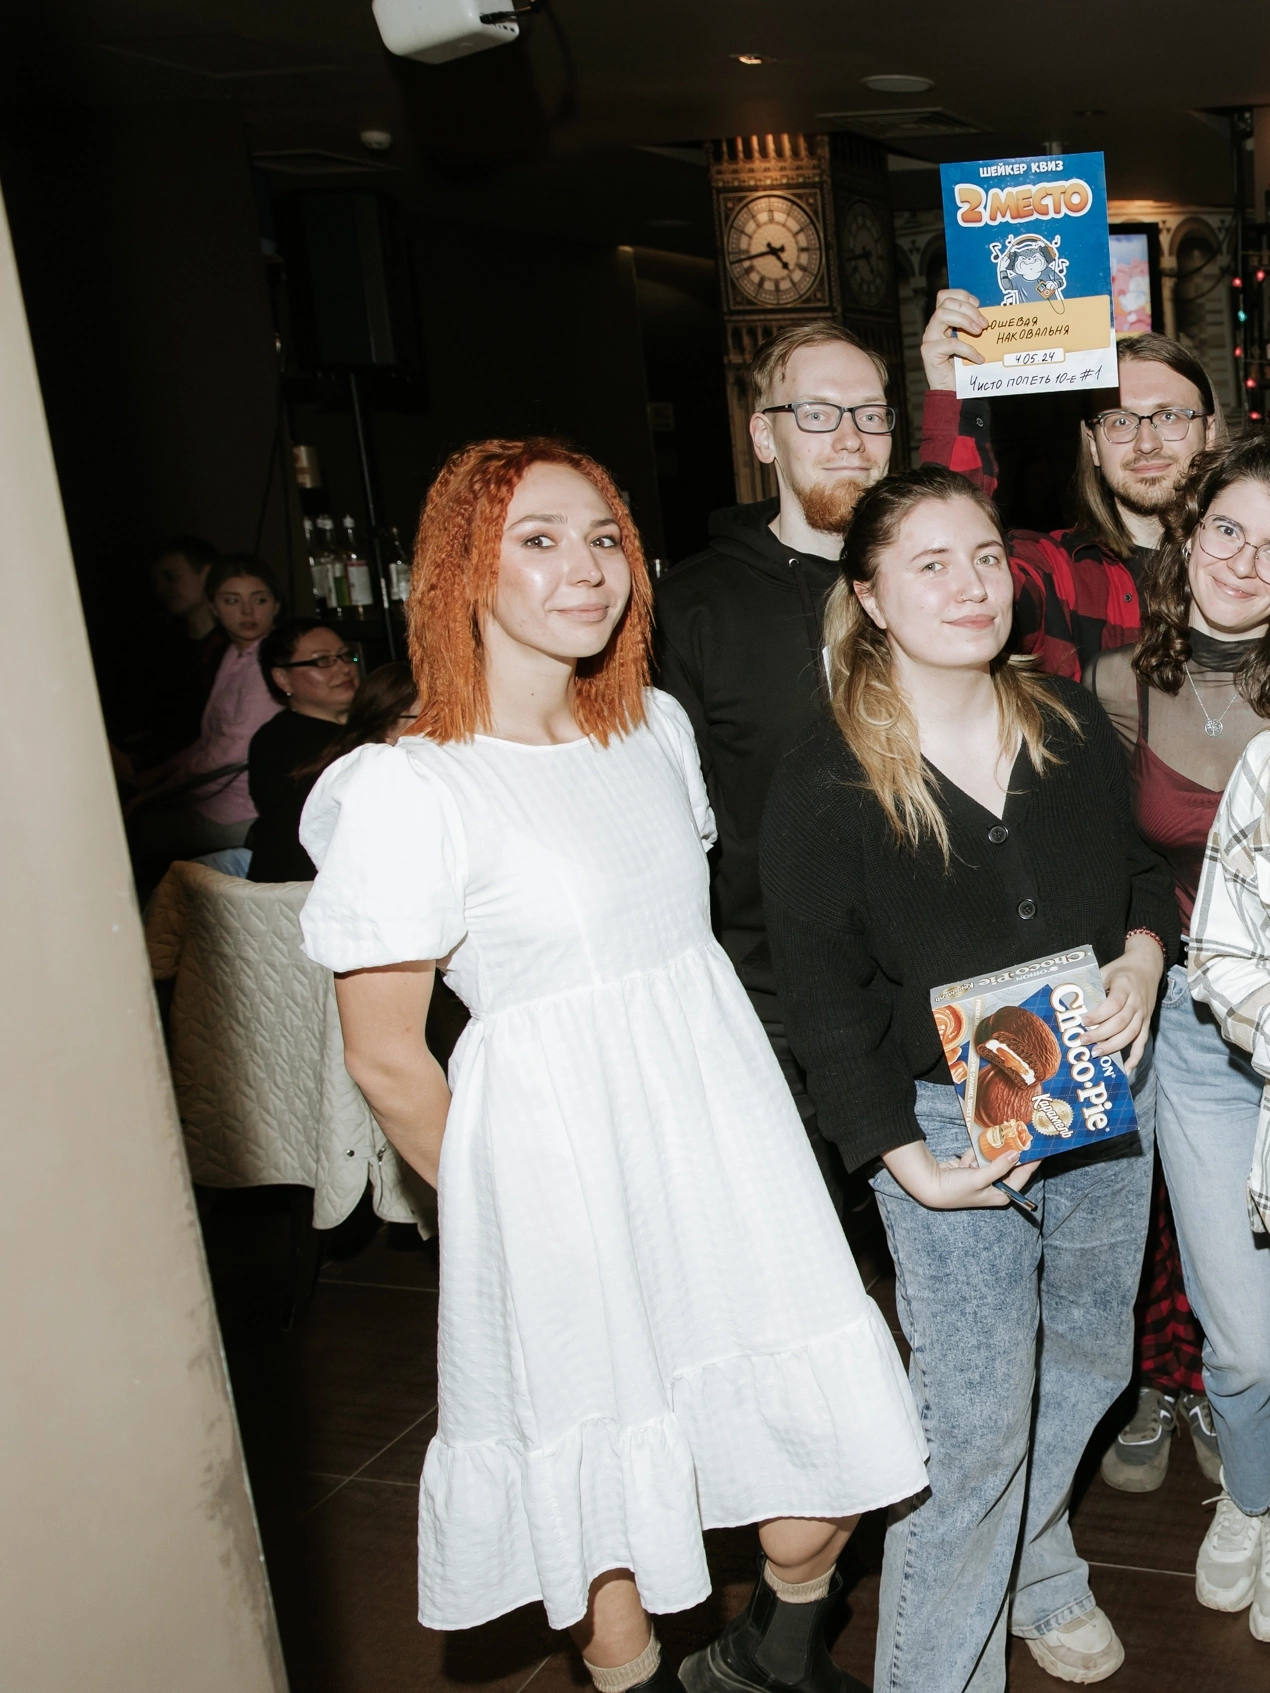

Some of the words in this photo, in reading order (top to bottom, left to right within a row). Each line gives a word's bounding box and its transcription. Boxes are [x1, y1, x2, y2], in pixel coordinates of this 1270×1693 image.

[979, 161, 1027, 178] ШЕЙКЕР
[1030, 160, 1064, 174] КВИЗ
[955, 184, 985, 227] 2
[987, 179, 1092, 224] МЕСТО
[984, 316, 1039, 331] ЮШЕВАЯ
[996, 324, 1070, 345] НАКОВАЛЬНЯ
[1014, 351, 1056, 365] 4.05.24
[969, 374, 1003, 392] Чисто
[1031, 1092, 1074, 1139] Карамель
